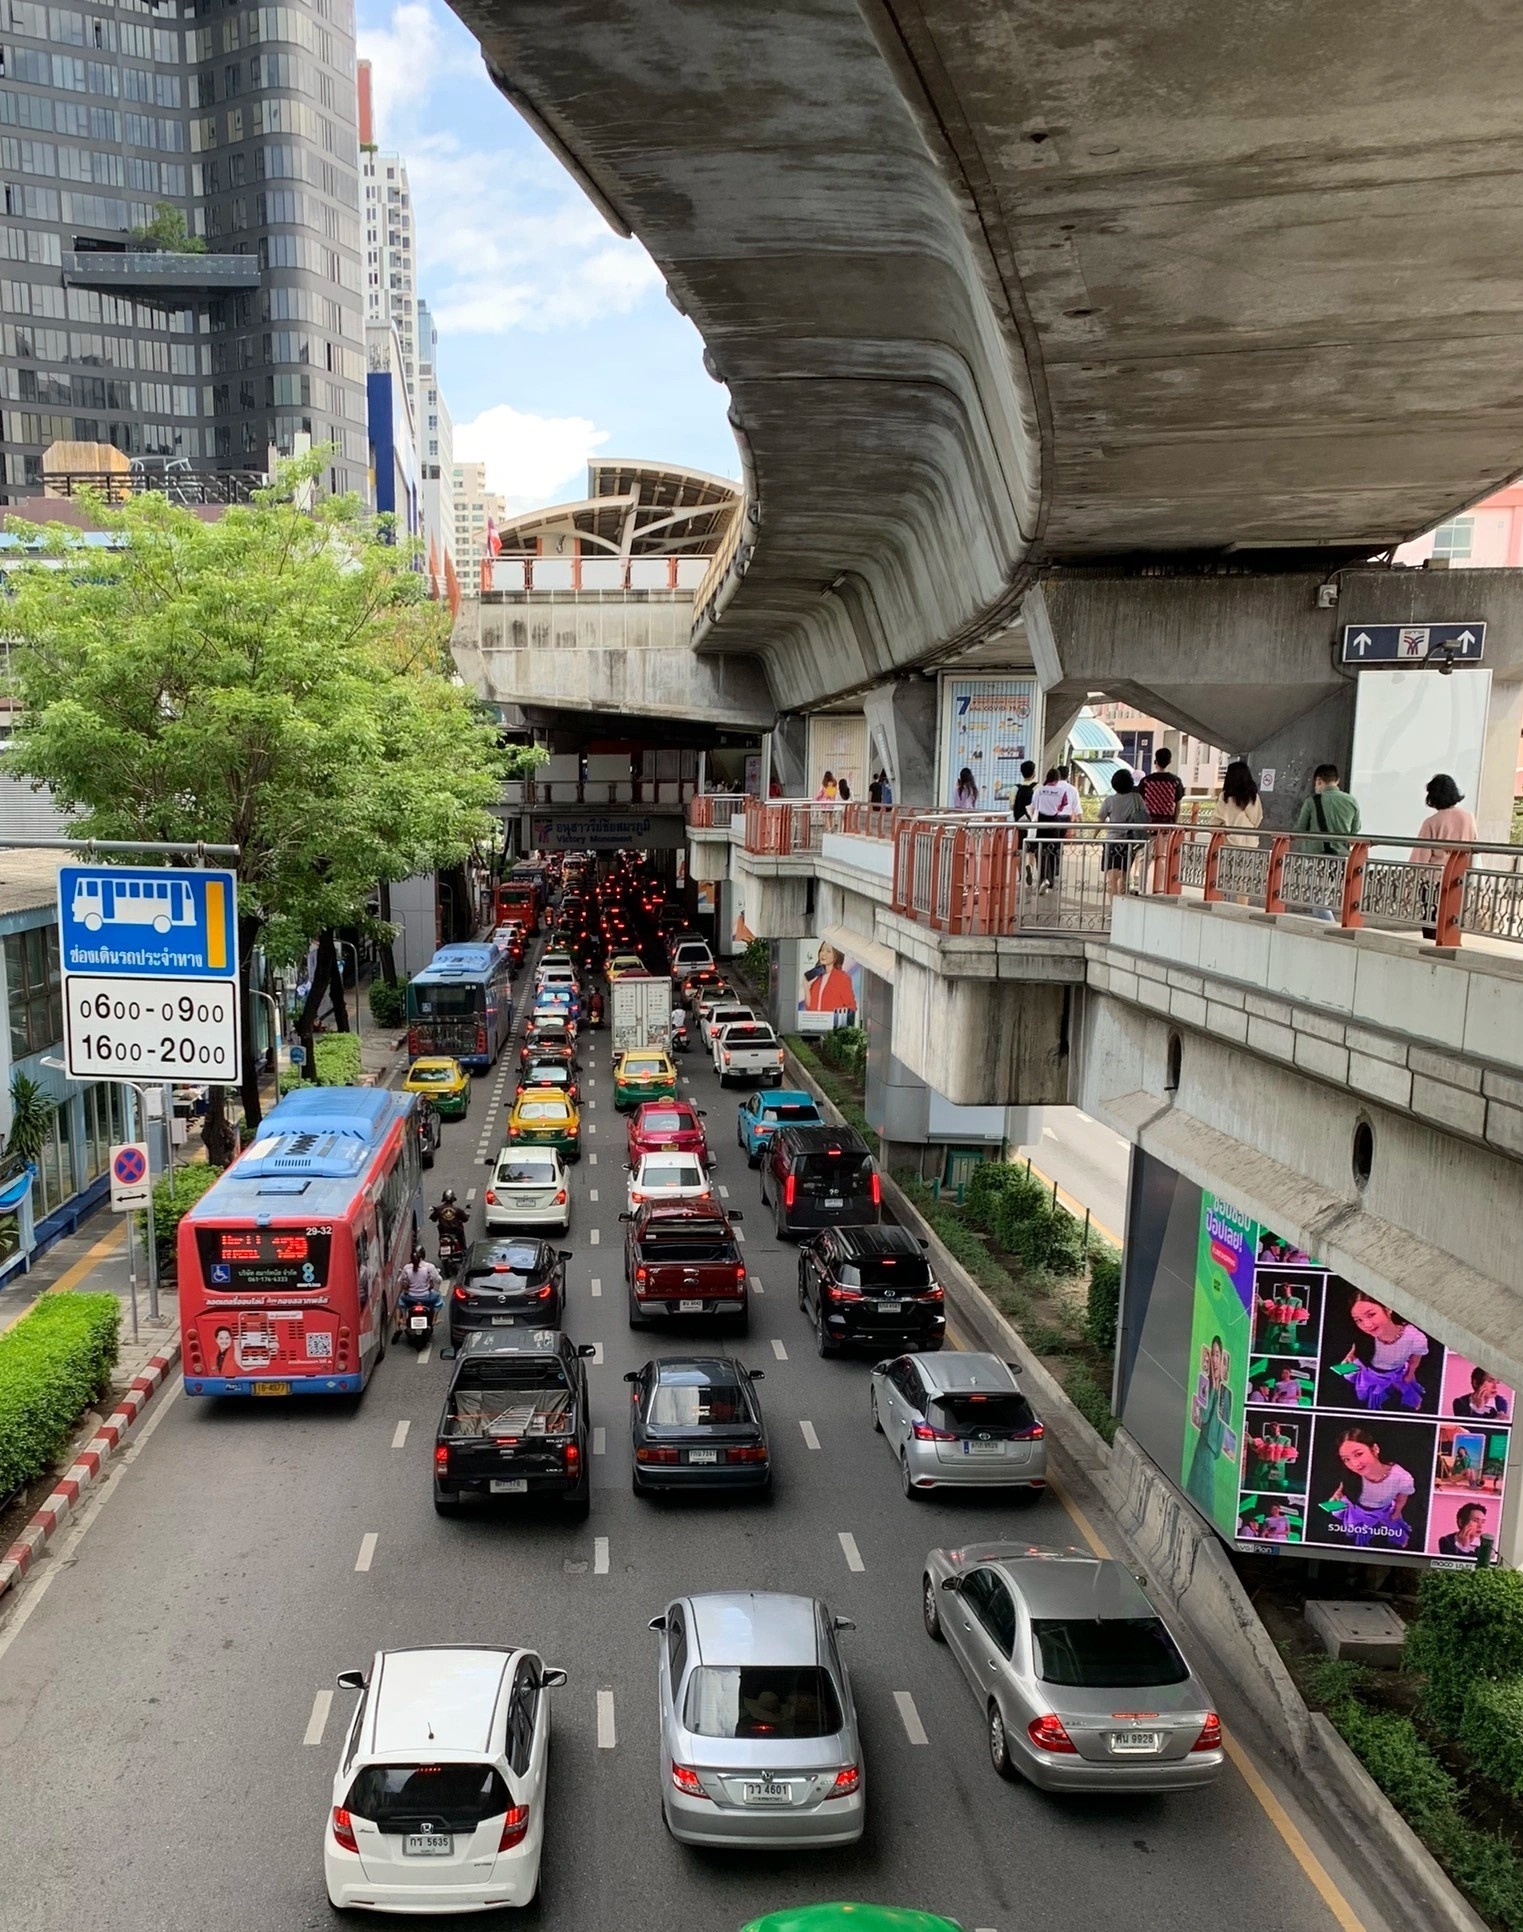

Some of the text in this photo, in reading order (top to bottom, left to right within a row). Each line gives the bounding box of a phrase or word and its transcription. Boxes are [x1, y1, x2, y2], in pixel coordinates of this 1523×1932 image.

[957, 696, 971, 715] 7
[557, 835, 633, 845] Victory Monument
[70, 944, 203, 968] ช่องเดินรถประจำทาง
[306, 1226, 333, 1236] 29-32
[1131, 1733, 1154, 1744] 9928
[764, 1784, 787, 1795] 4601
[427, 1837, 449, 1847] 5635
